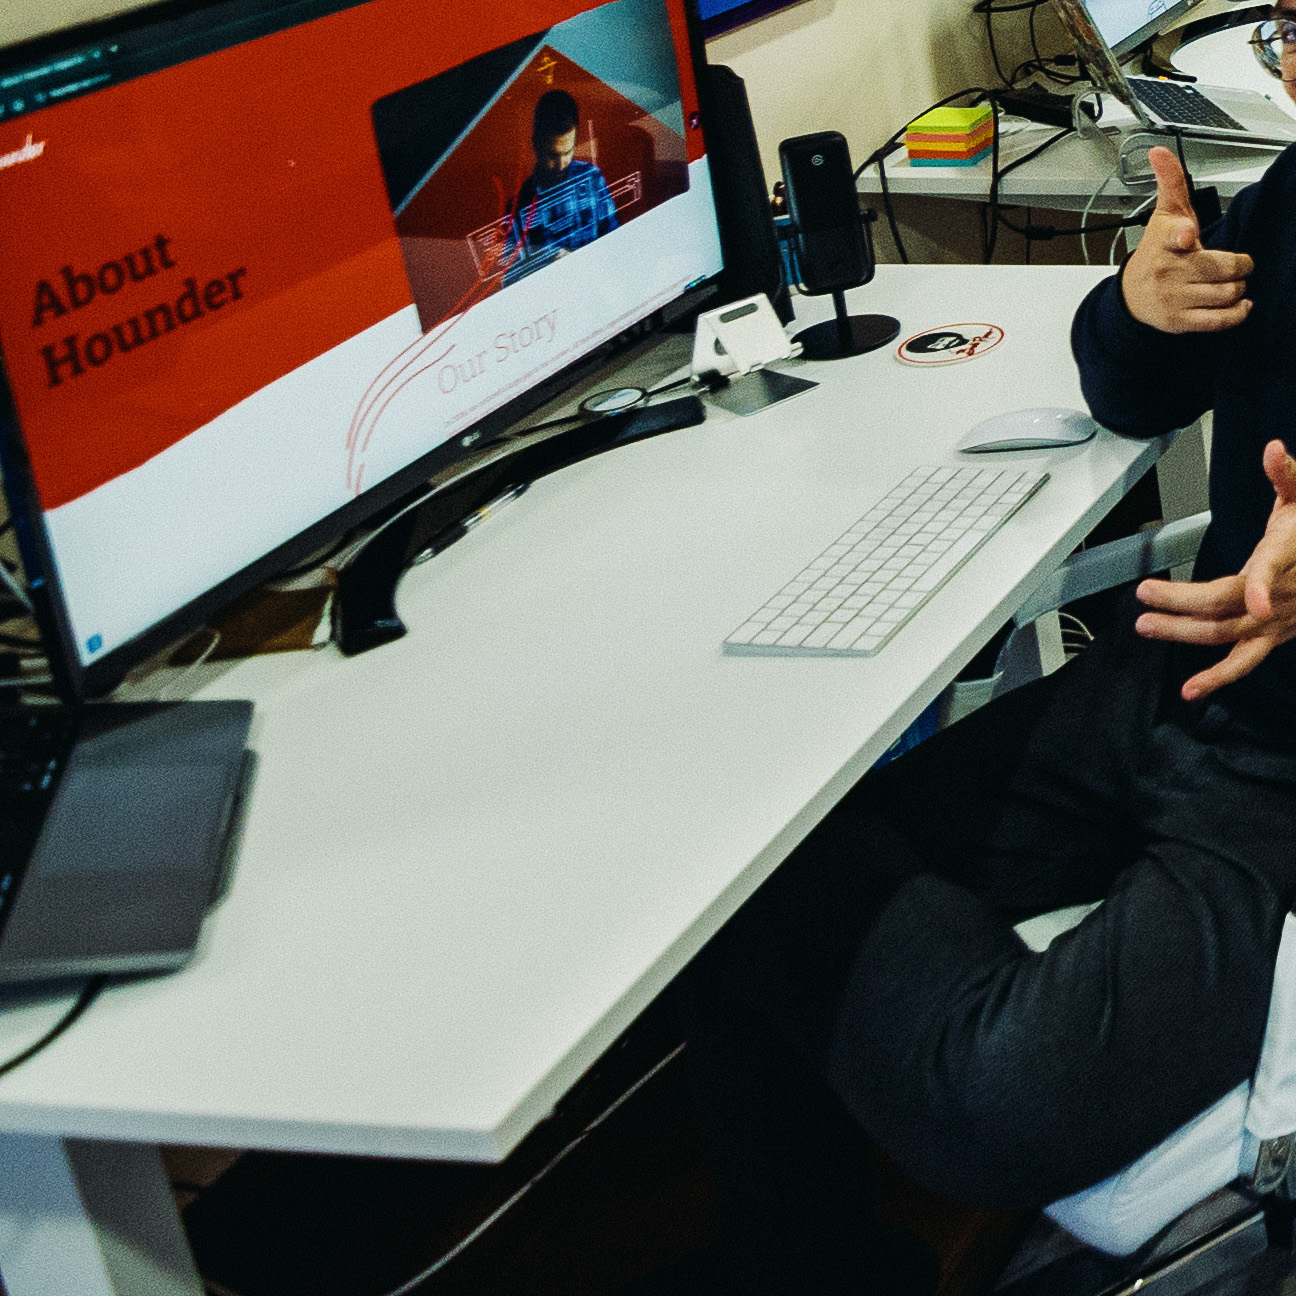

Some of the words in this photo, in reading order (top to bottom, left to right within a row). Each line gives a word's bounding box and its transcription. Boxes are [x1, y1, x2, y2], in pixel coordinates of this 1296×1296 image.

[31, 234, 177, 328] About
[42, 266, 249, 388] Hounder
[437, 351, 487, 395] Our
[493, 308, 558, 363] Story
